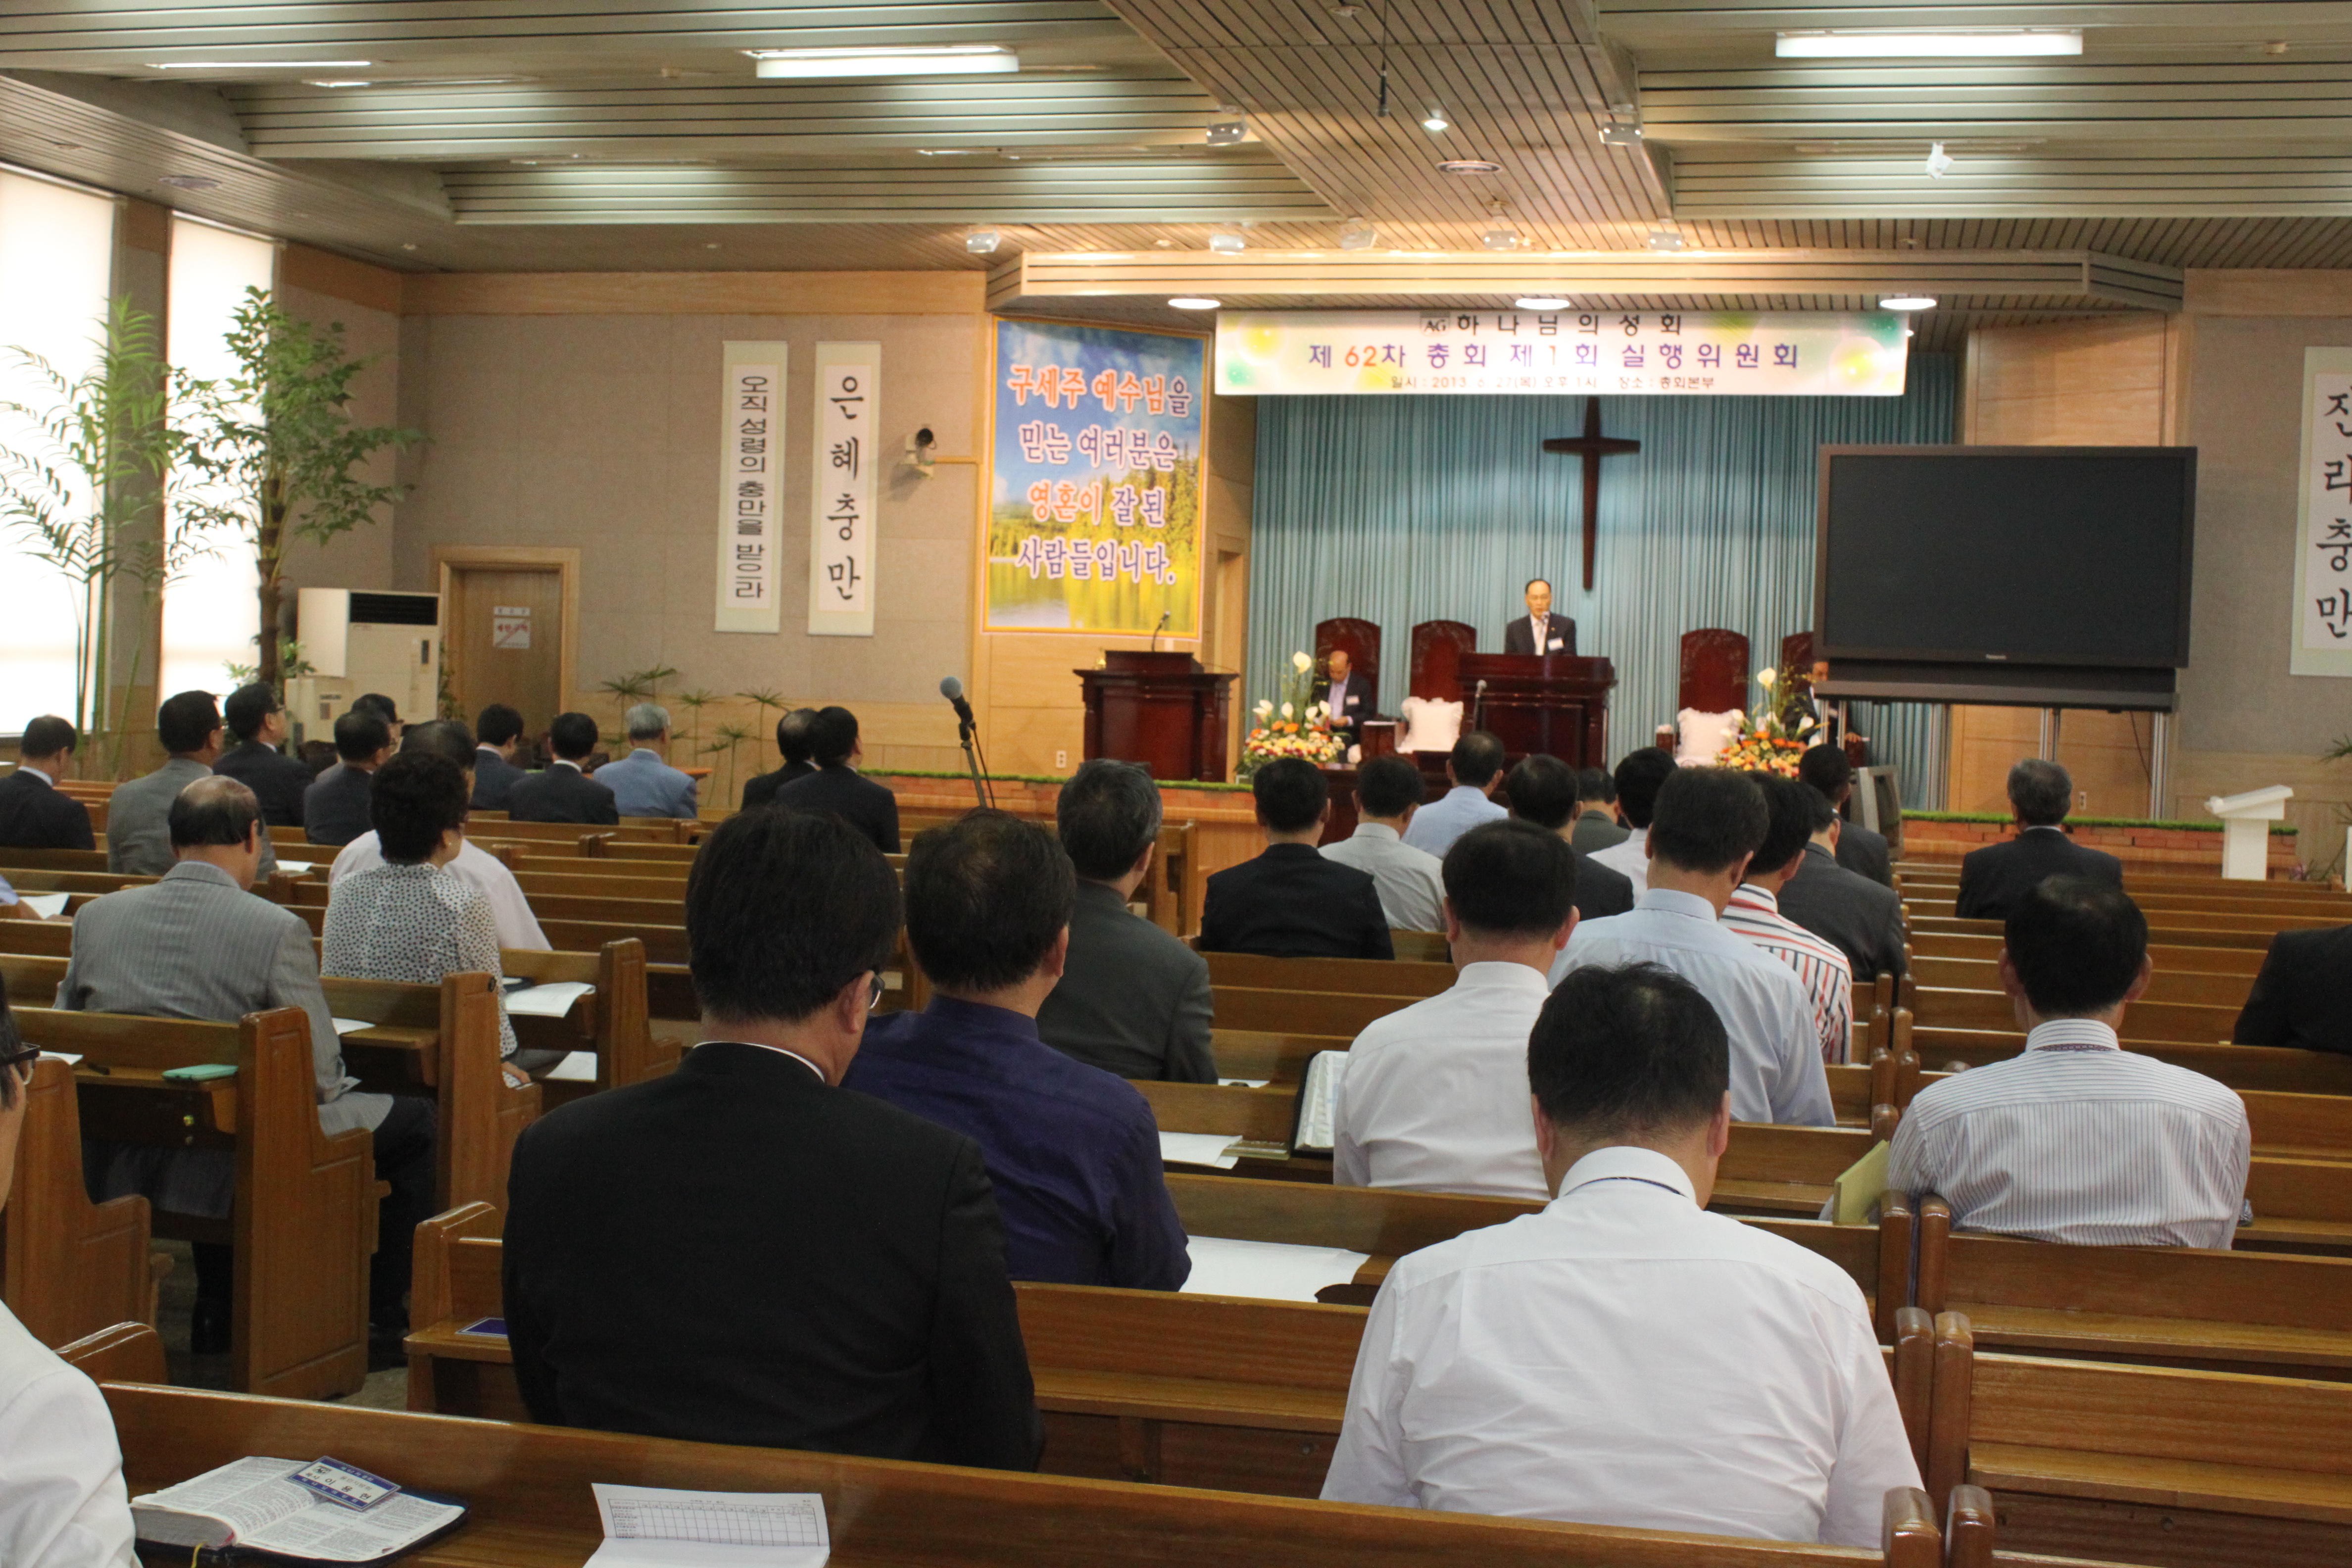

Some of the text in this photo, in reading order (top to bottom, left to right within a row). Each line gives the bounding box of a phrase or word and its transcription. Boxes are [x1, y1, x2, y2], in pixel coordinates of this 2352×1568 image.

[1427, 343, 1486, 369] 총회
[1621, 343, 1799, 369] 실행위원회
[1010, 367, 1190, 415] 구세주 예수님을
[1544, 376, 1569, 389] 오후
[1660, 376, 1715, 390] 총회본부
[1020, 423, 1176, 469] 믿는 여러분은
[735, 375, 768, 599] 오직 성령의 충만을 받으라
[1029, 482, 1100, 523] 영혼이
[1016, 537, 1175, 583] 사람들입니다.
